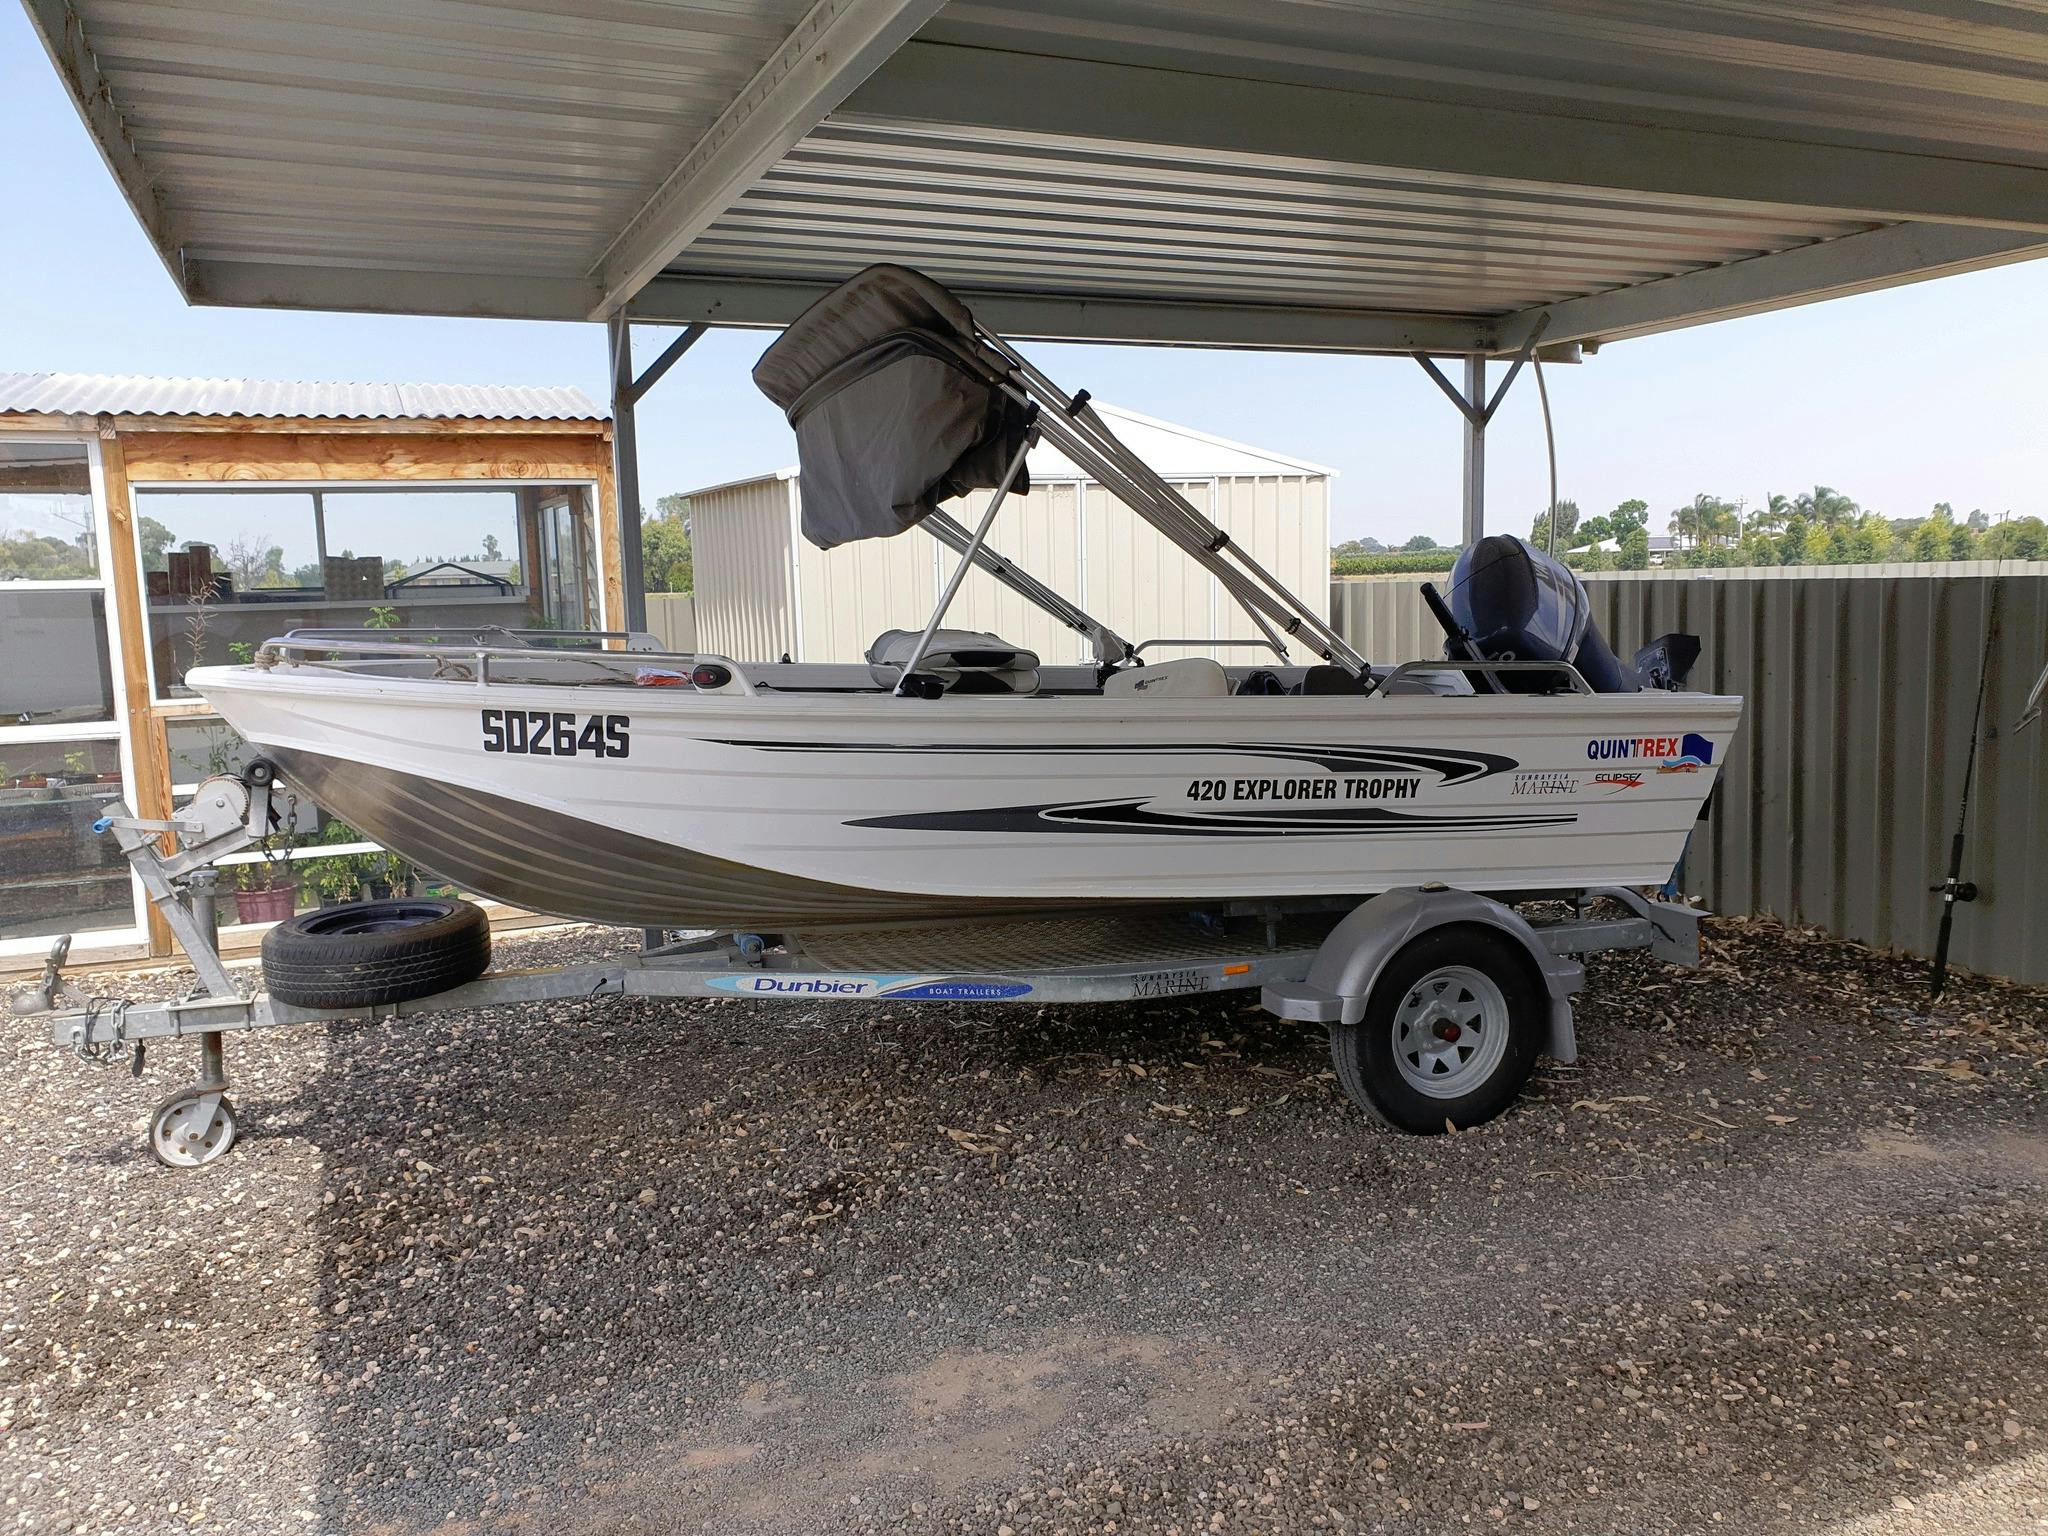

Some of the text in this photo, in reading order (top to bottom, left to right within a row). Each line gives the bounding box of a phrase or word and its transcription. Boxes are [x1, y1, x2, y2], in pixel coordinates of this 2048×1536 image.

[481, 709, 630, 758] SD264S
[1587, 738, 1679, 760] QUINTREX
[1514, 773, 1569, 782] SUNRAYSIA
[1595, 772, 1637, 782] ECLIPSE
[1187, 778, 1421, 800] 420 EXPLORER TROPHY
[1511, 780, 1580, 796] MARINE
[754, 978, 868, 994] Dunbier
[958, 988, 1001, 996] TRAILERS
[1133, 976, 1209, 997] MARINE
